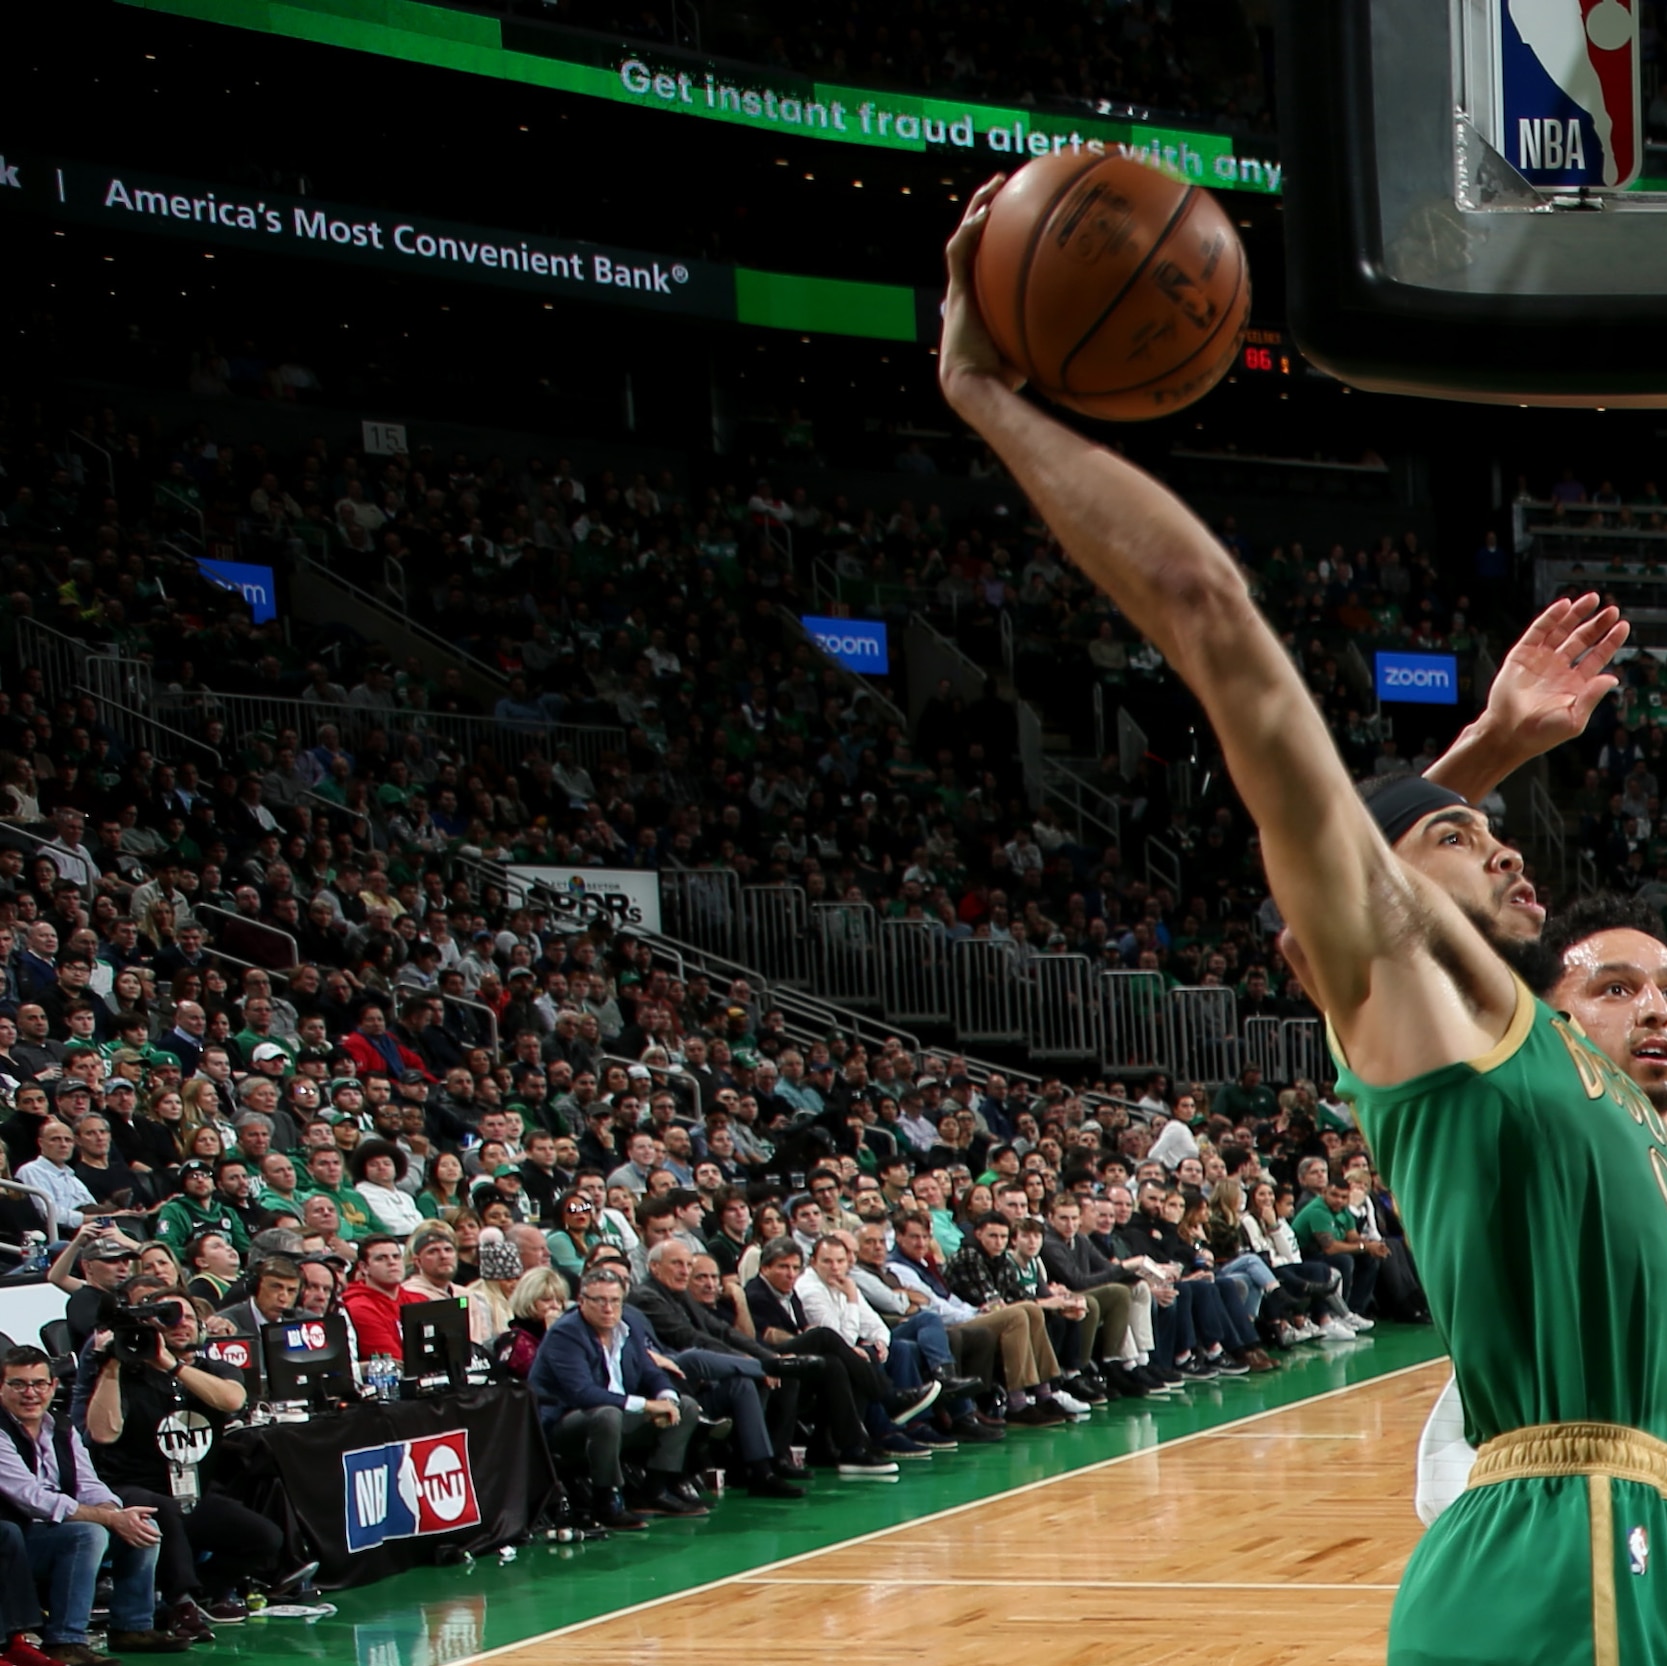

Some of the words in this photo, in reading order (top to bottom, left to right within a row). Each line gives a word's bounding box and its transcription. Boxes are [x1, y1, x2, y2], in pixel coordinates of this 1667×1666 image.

[619, 59, 694, 104] Get
[703, 73, 847, 131] instant
[858, 101, 975, 149] fraud
[1117, 139, 1203, 178] with
[1212, 156, 1284, 194] any
[1517, 117, 1587, 171] NBA
[103, 178, 283, 234] America's
[293, 209, 384, 251] Most
[393, 226, 585, 281] Convenient
[371, 426, 406, 452] 15
[815, 632, 878, 658] zoom
[1384, 666, 1450, 689] zoom
[157, 1428, 213, 1452] TNT
[422, 1468, 466, 1504] TNT
